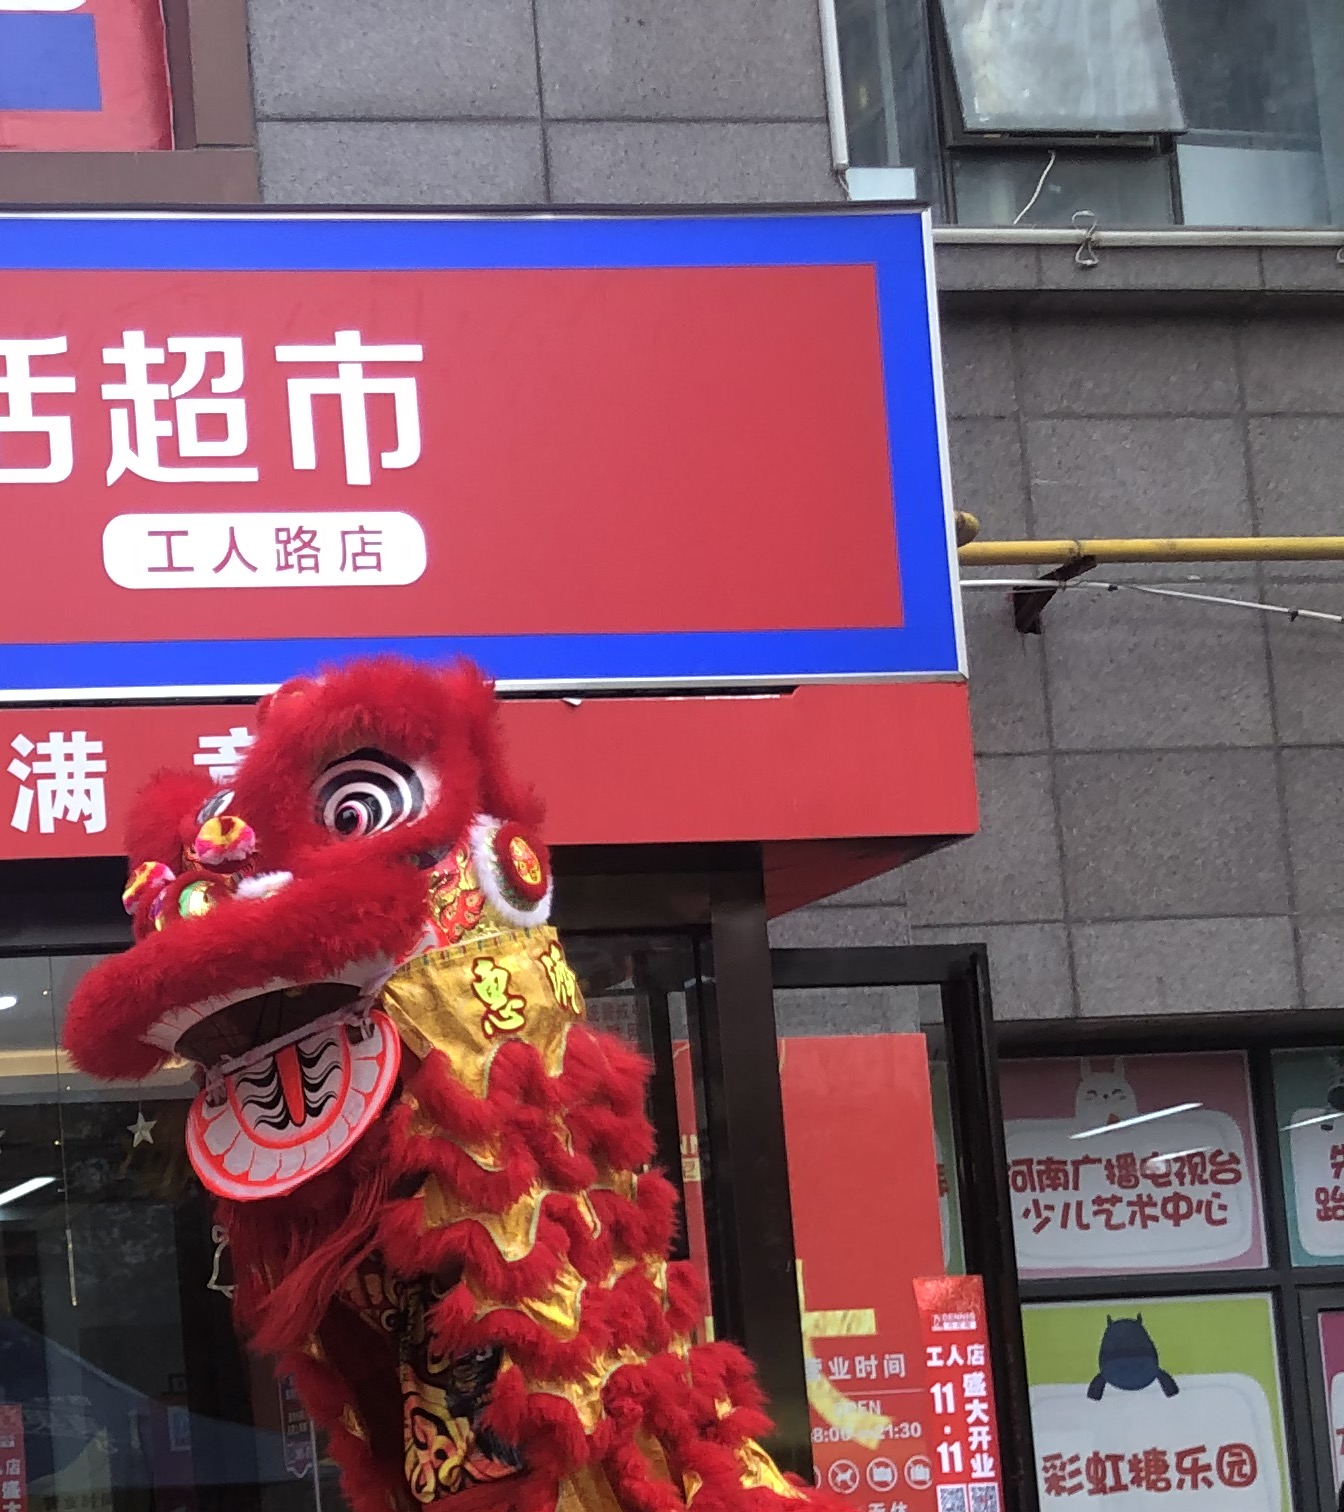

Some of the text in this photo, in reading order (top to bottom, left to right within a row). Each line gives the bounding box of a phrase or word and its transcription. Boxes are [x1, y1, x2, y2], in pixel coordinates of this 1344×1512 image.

[145, 522, 386, 576] 工人路店
[1022, 1191, 1228, 1235] 少儿艺术中心
[925, 1343, 985, 1367] 工人店
[963, 1370, 996, 1479] 盛大开业
[1041, 1441, 1258, 1497] 彩虹糖乐园
